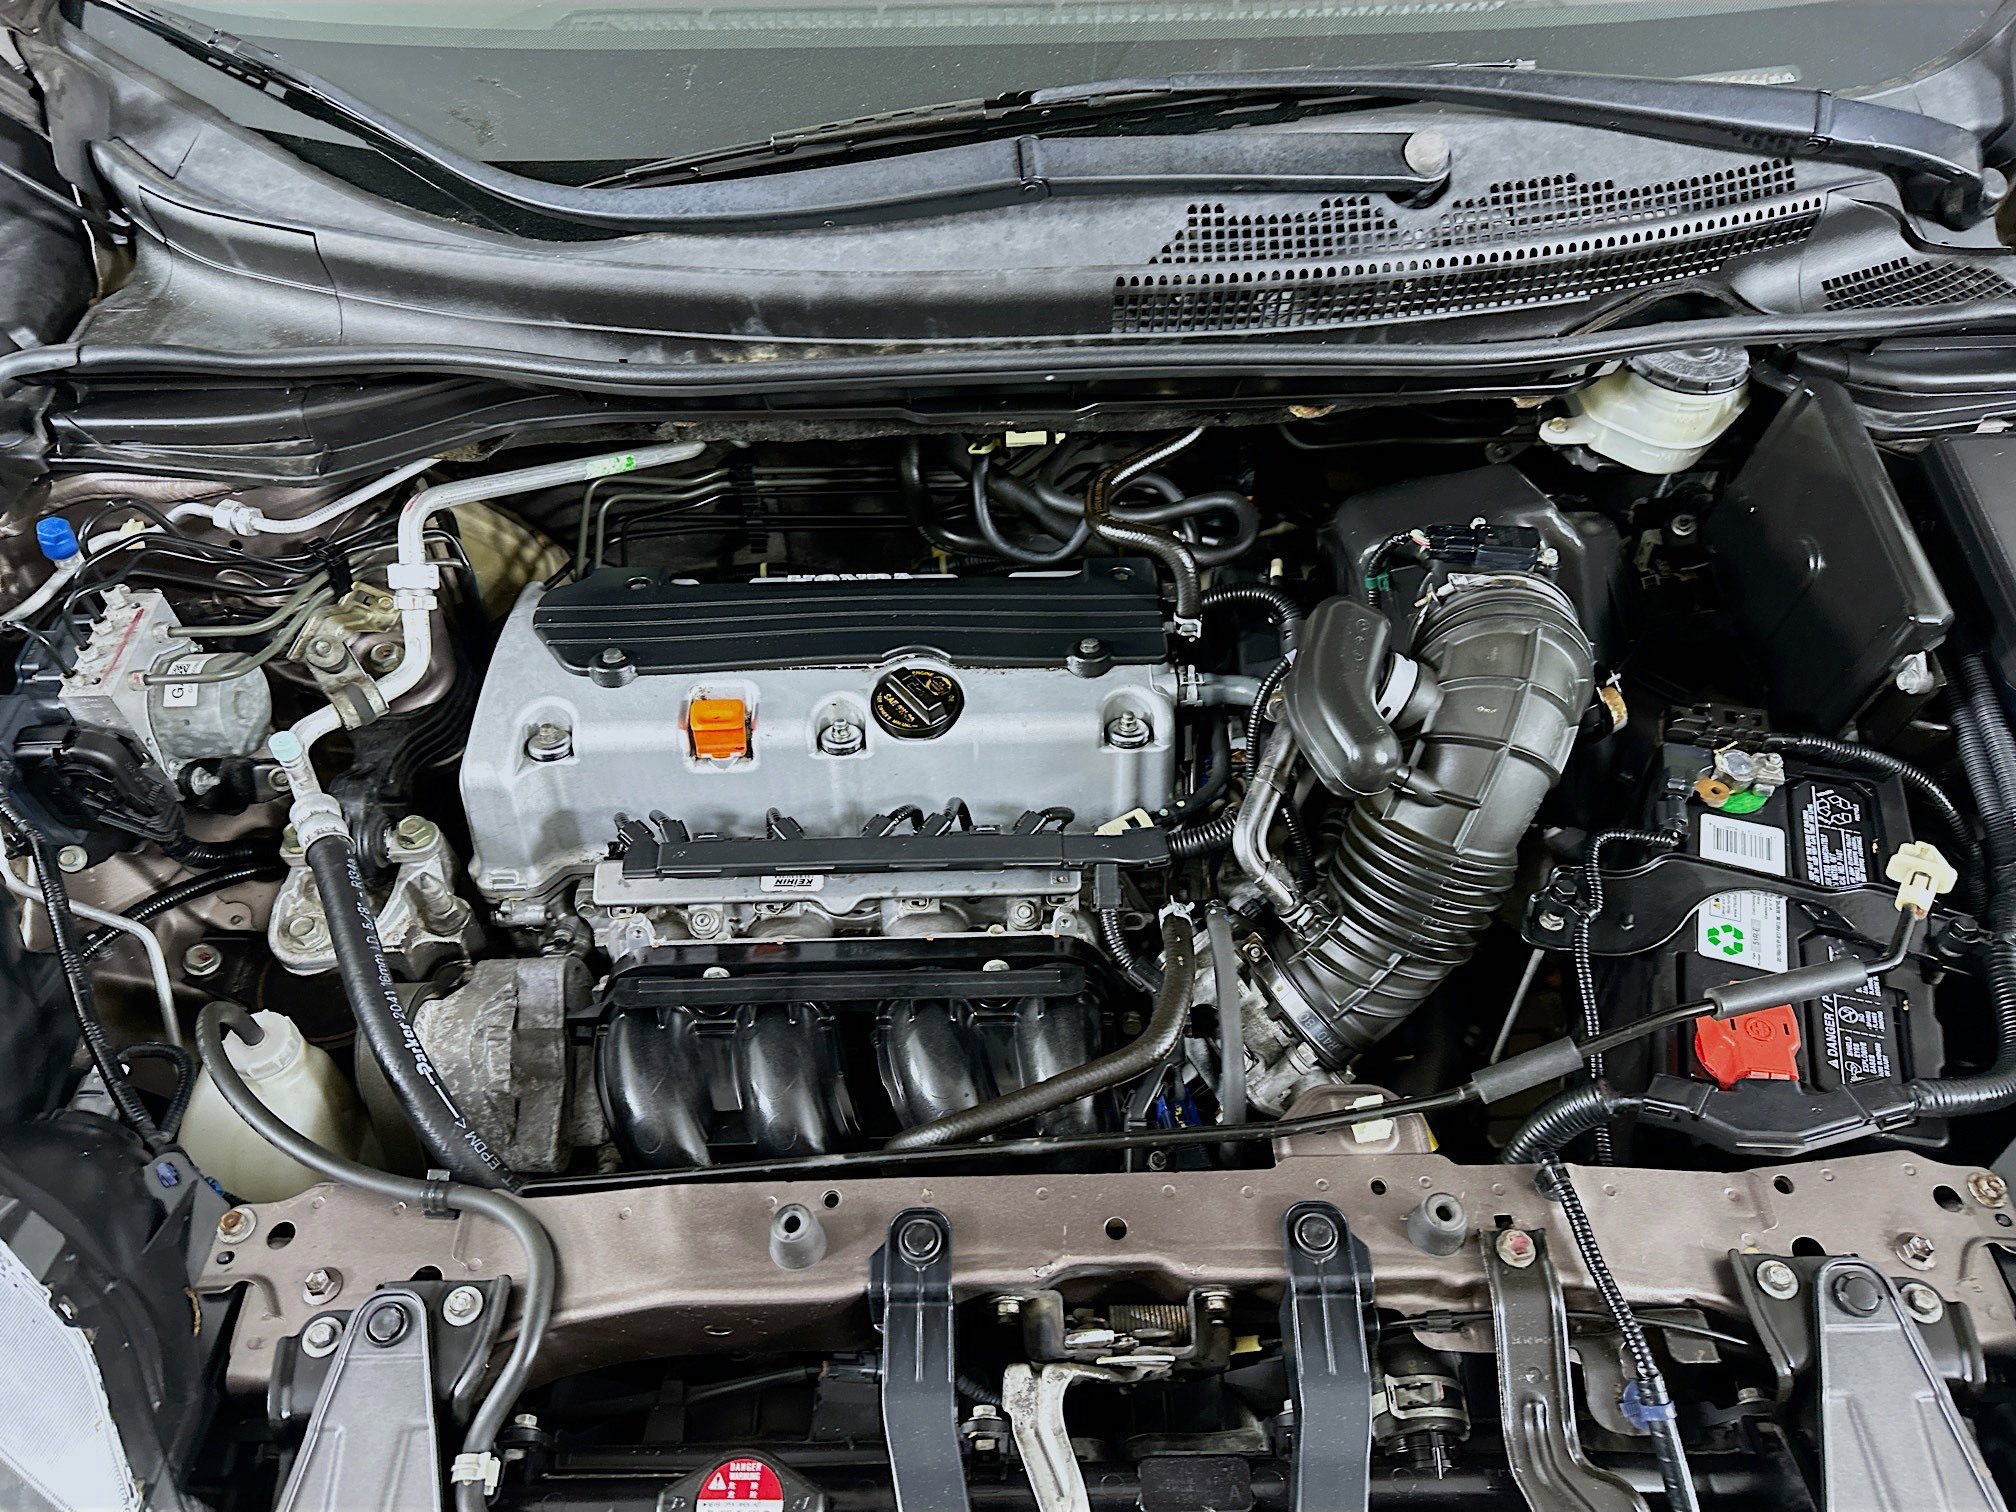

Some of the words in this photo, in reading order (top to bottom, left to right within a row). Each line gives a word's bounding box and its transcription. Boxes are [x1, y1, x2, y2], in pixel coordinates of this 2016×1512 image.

[773, 879, 814, 887] KEIHIN
[374, 954, 393, 987] 16mm
[384, 990, 406, 1022] 2041
[400, 1022, 434, 1077] Parker
[464, 1130, 501, 1171] EPDM
[729, 1462, 762, 1472] DANGER
[729, 1472, 761, 1480] WARNING
